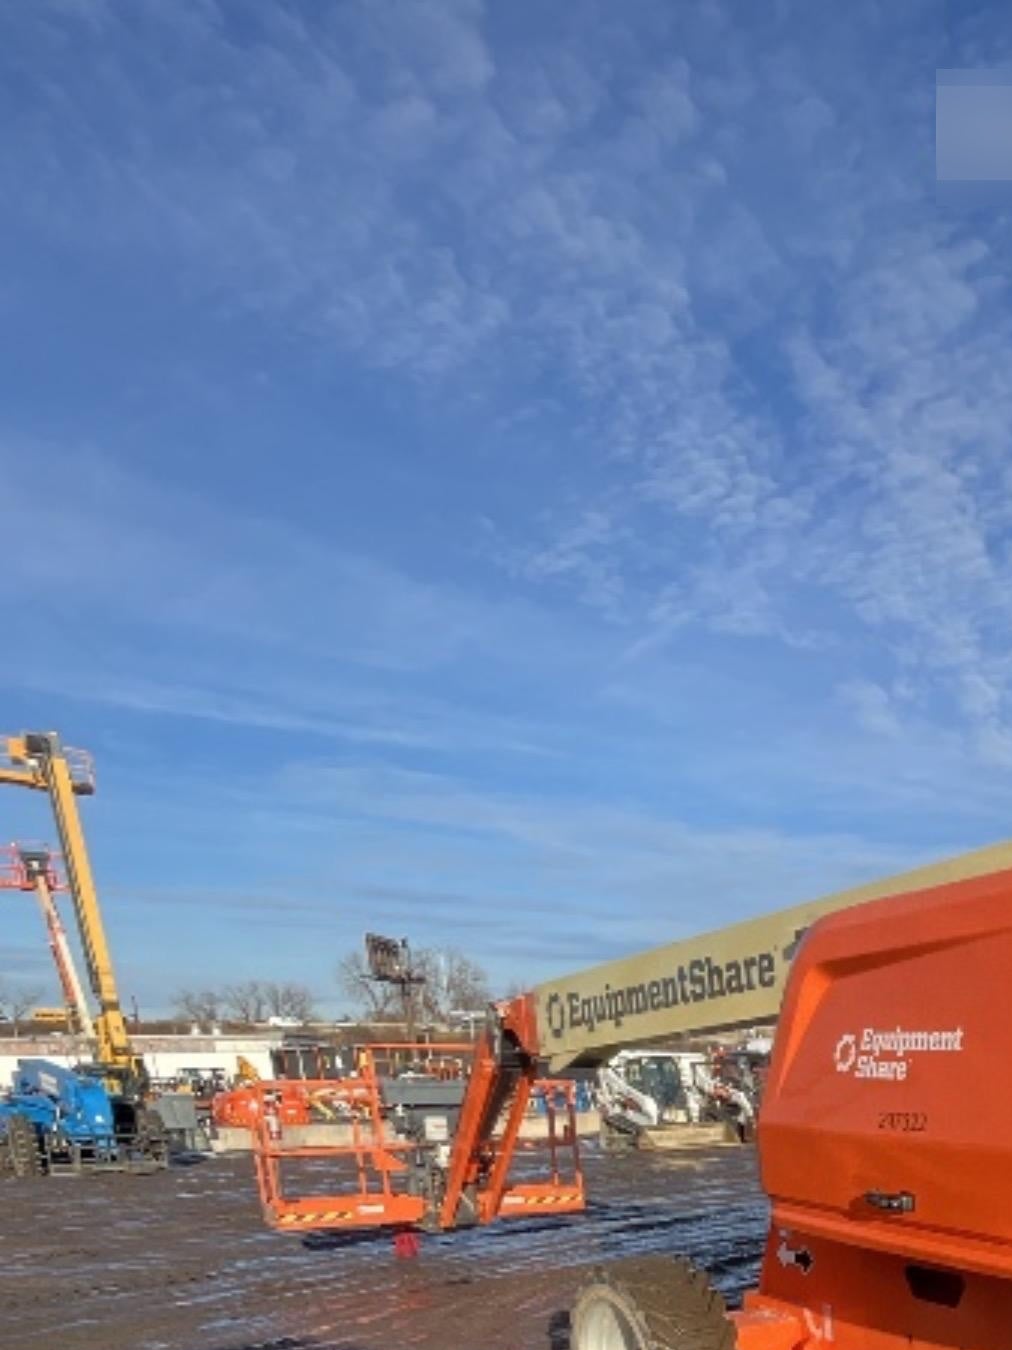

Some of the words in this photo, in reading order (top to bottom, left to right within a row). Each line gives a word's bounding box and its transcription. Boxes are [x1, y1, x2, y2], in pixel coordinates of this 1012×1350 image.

[568, 951, 775, 1033] EquipmentShare
[861, 1025, 964, 1057] Equipment
[854, 1055, 907, 1081] Share
